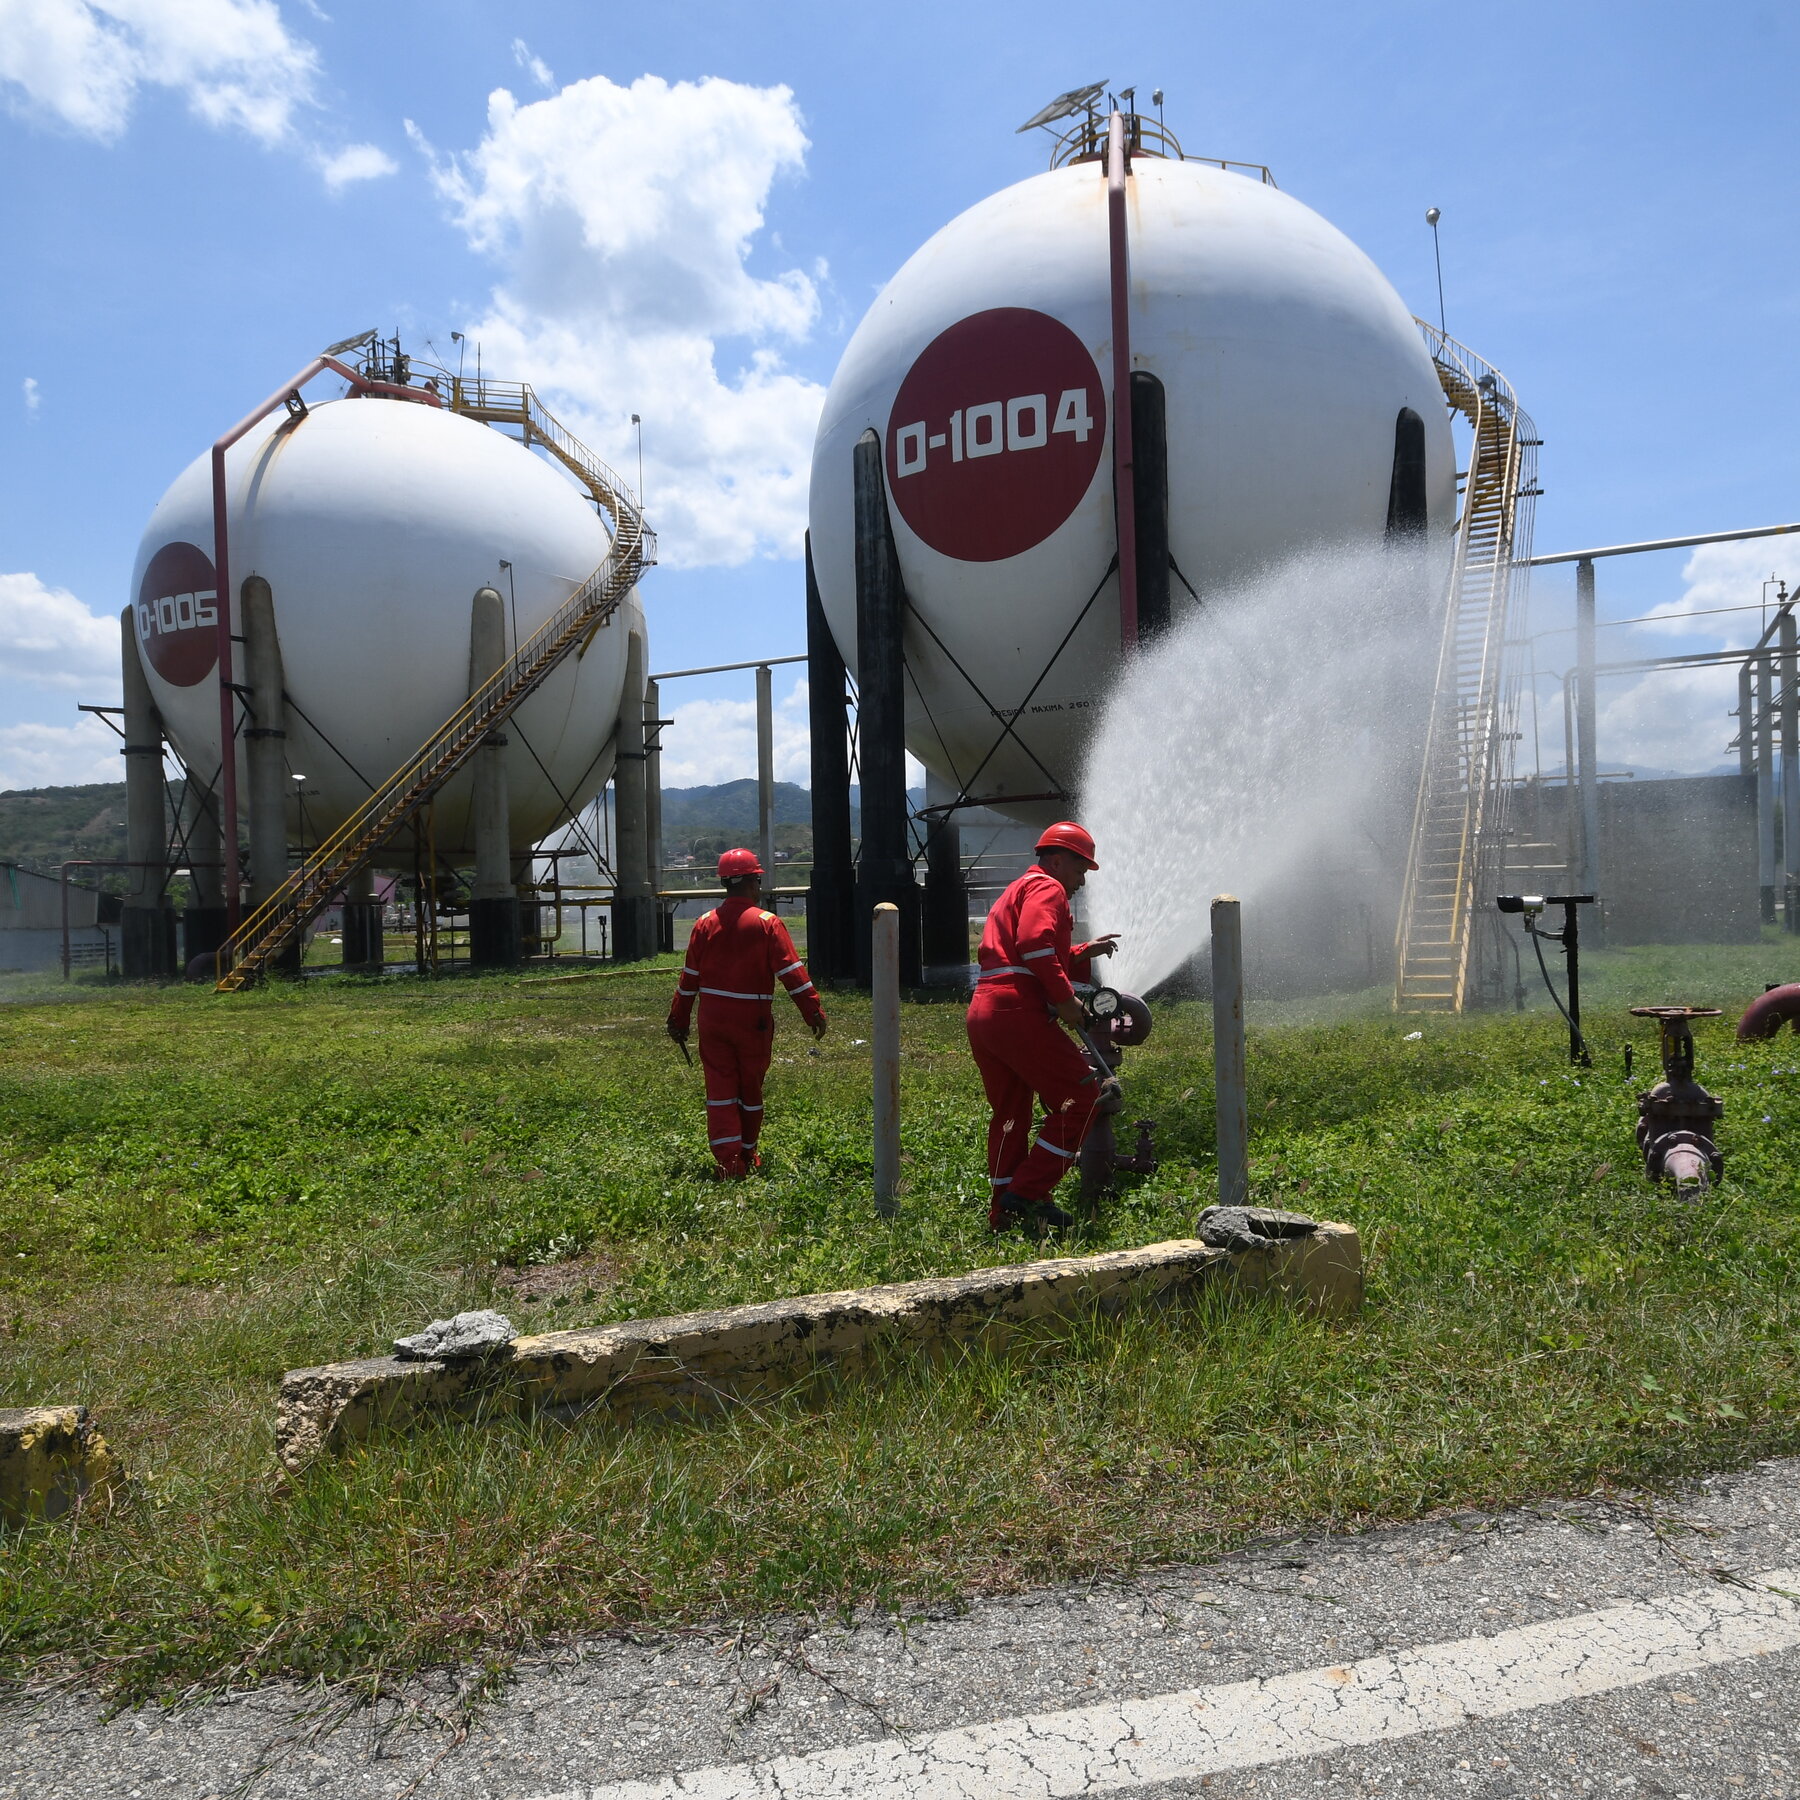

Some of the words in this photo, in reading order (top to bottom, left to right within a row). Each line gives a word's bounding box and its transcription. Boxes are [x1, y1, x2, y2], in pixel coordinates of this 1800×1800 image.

[897, 388, 1094, 478] D-1004
[139, 590, 218, 640] D-1005
[1031, 704, 1064, 713] MAXIMA
